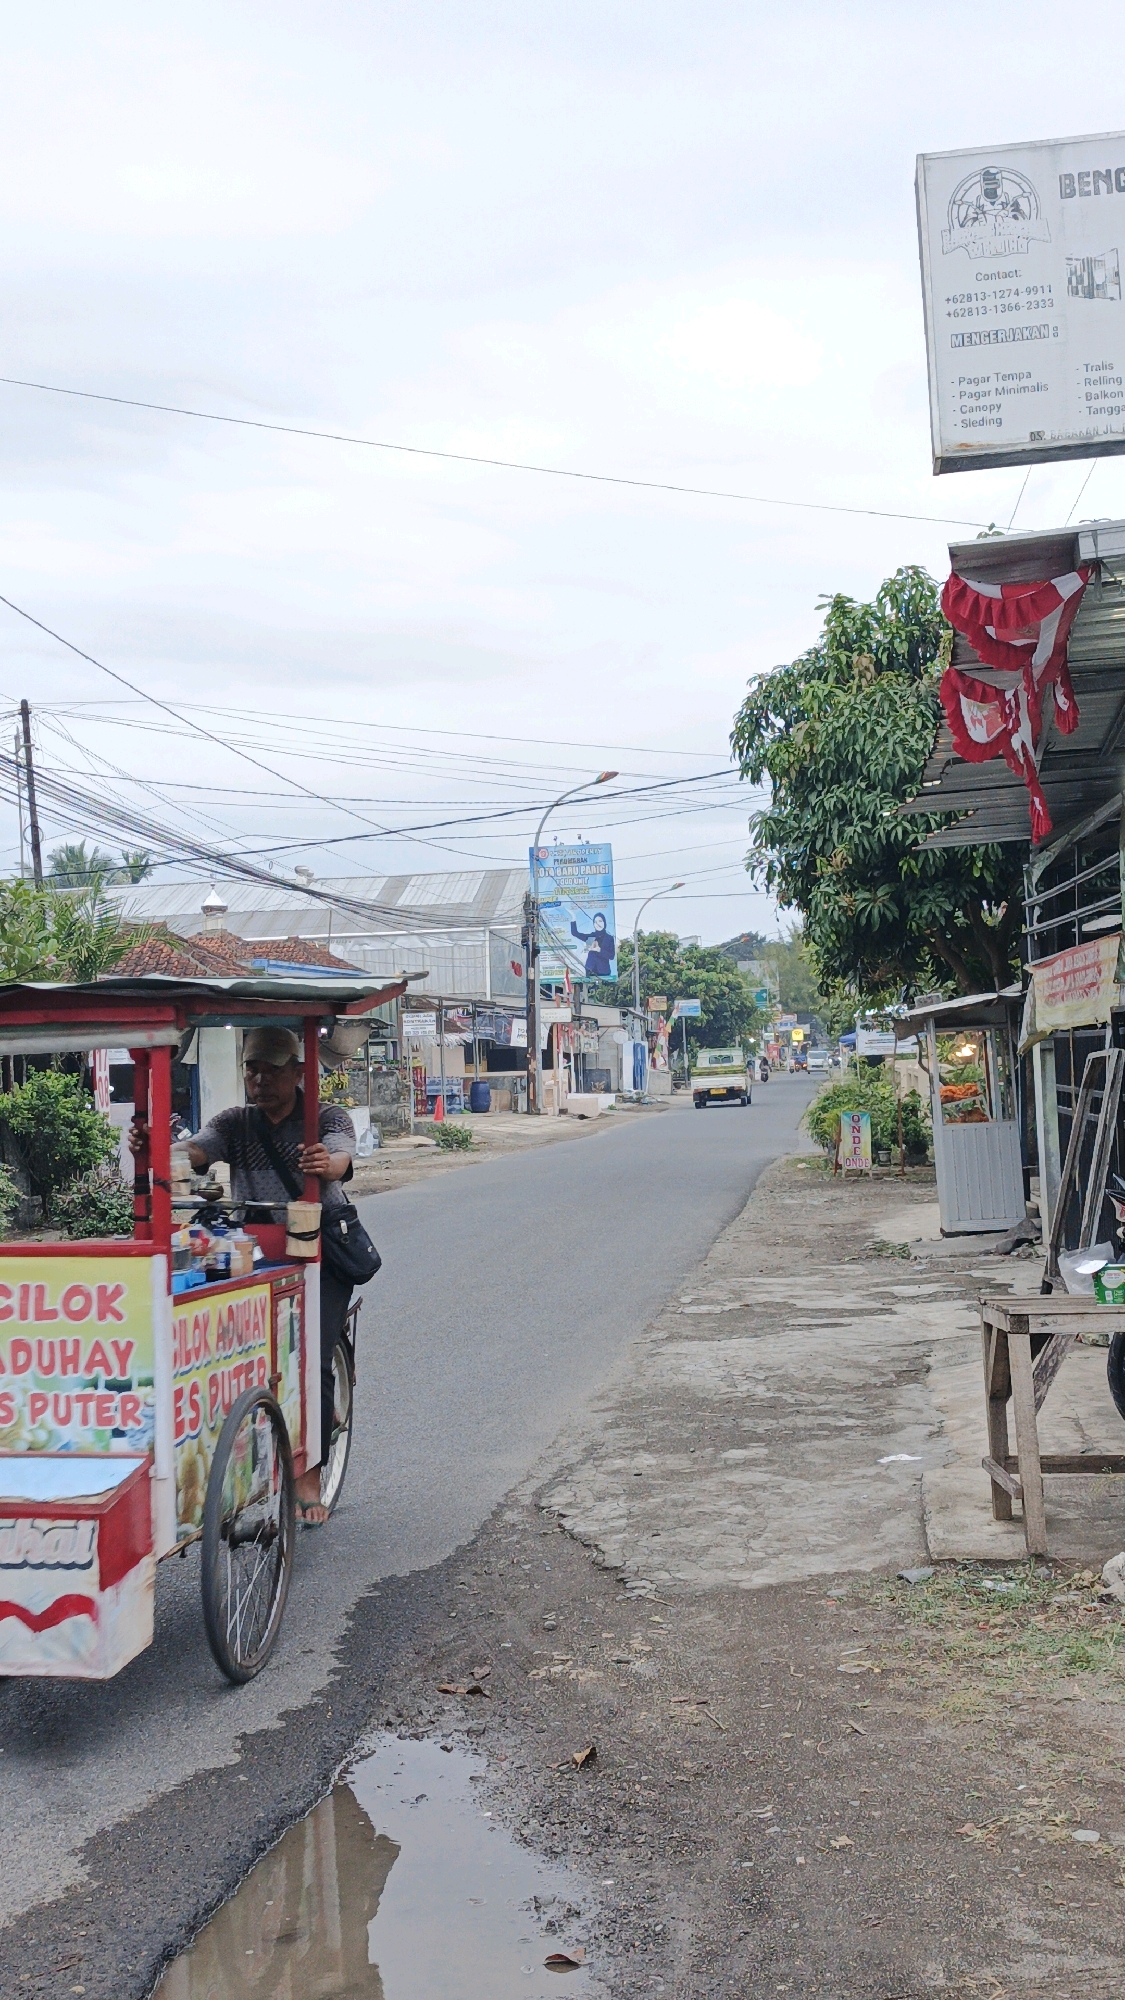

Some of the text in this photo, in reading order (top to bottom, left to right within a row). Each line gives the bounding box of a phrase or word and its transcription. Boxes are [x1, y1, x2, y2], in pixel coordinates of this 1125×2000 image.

[945, 284, 1052, 304] +62813-1274-9911
[945, 298, 1054, 318] +62813-1366-2333
[950, 324, 1050, 348] MENGERJAKAN
[1083, 360, 1114, 373] Tralis
[958, 371, 1032, 387] Pagar Tempa
[959, 382, 1049, 401] Pagar Minimalis
[960, 402, 1002, 415] Canopy
[961, 416, 1003, 429] Sleding
[851, 1114, 861, 1156] ONDE
[845, 1157, 869, 1168] ONDE
[30, 1392, 142, 1428] PUTER
[173, 1380, 200, 1440] ES
